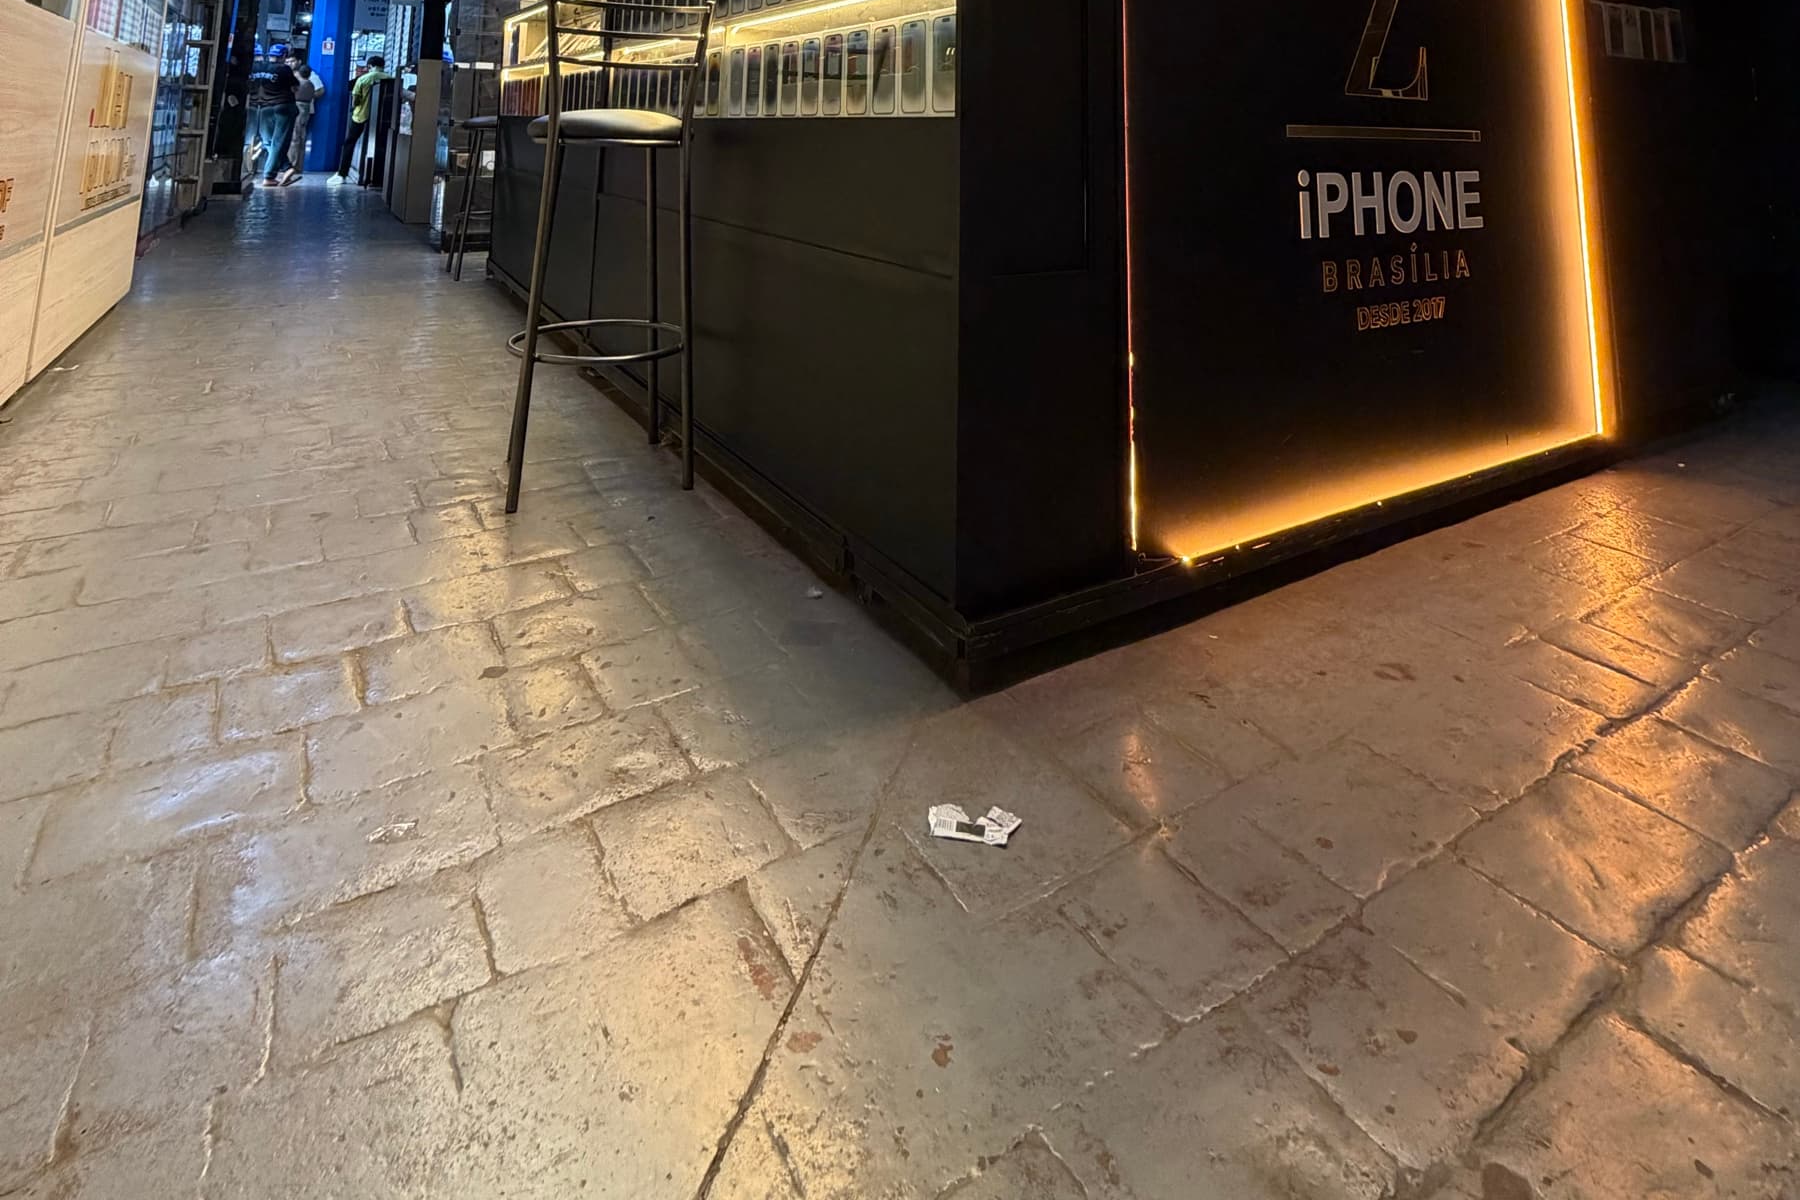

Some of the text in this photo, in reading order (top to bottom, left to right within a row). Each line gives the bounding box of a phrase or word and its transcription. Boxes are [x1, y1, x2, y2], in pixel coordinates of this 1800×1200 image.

[1298, 170, 1484, 239] iPHONE
[1322, 243, 1470, 293] BRASÍLIA
[1356, 297, 1446, 331] DESDE 2017
